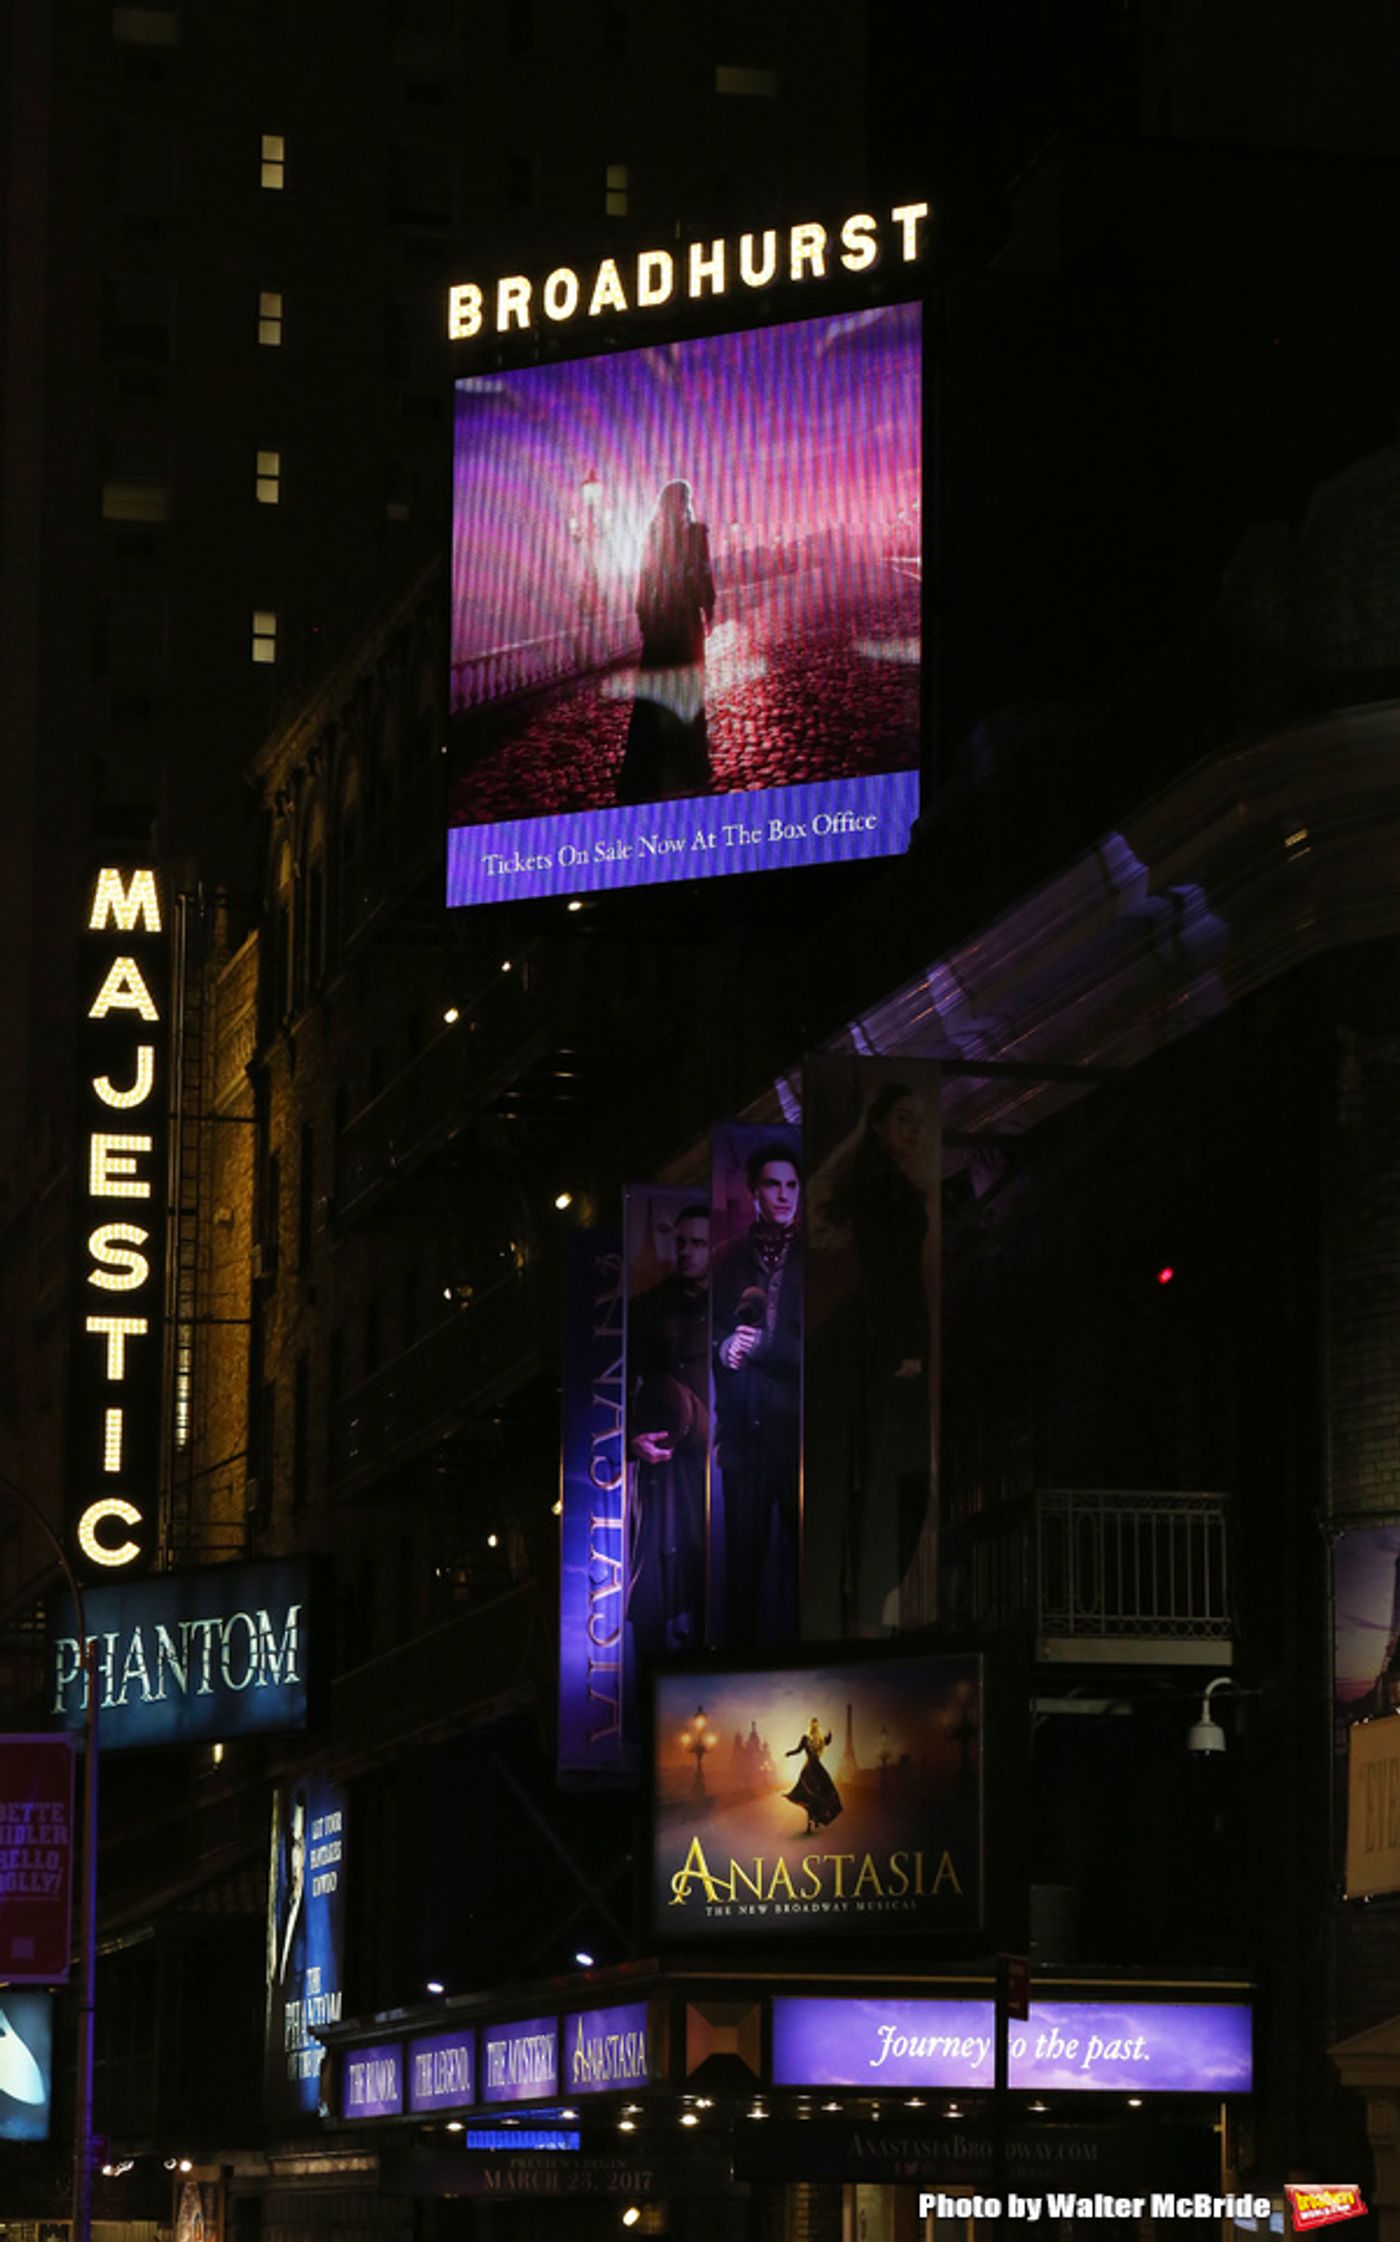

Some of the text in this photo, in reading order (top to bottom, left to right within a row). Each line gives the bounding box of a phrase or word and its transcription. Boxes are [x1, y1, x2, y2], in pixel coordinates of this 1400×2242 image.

[449, 203, 928, 340] BROADHURST
[481, 811, 878, 877] Tickets On Sale Now At The Box Office
[78, 868, 162, 1567] MAJESTIC
[52, 1605, 301, 1713] PHANTOM
[0, 1824, 69, 1845] IDLER
[667, 1836, 963, 1905] ANASTASIA
[705, 1900, 917, 1917] THE NEW BROADWAY MUSICAL
[573, 2015, 648, 2084] ANASTASIA
[870, 2026, 991, 2067] Journey
[1035, 2028, 1079, 2060] the
[1081, 2035, 1150, 2069] past.
[853, 2132, 1100, 2161] ANASTASIABRODWAY.COM
[482, 2168, 560, 2191] MARCH
[607, 2171, 654, 2192] 2017
